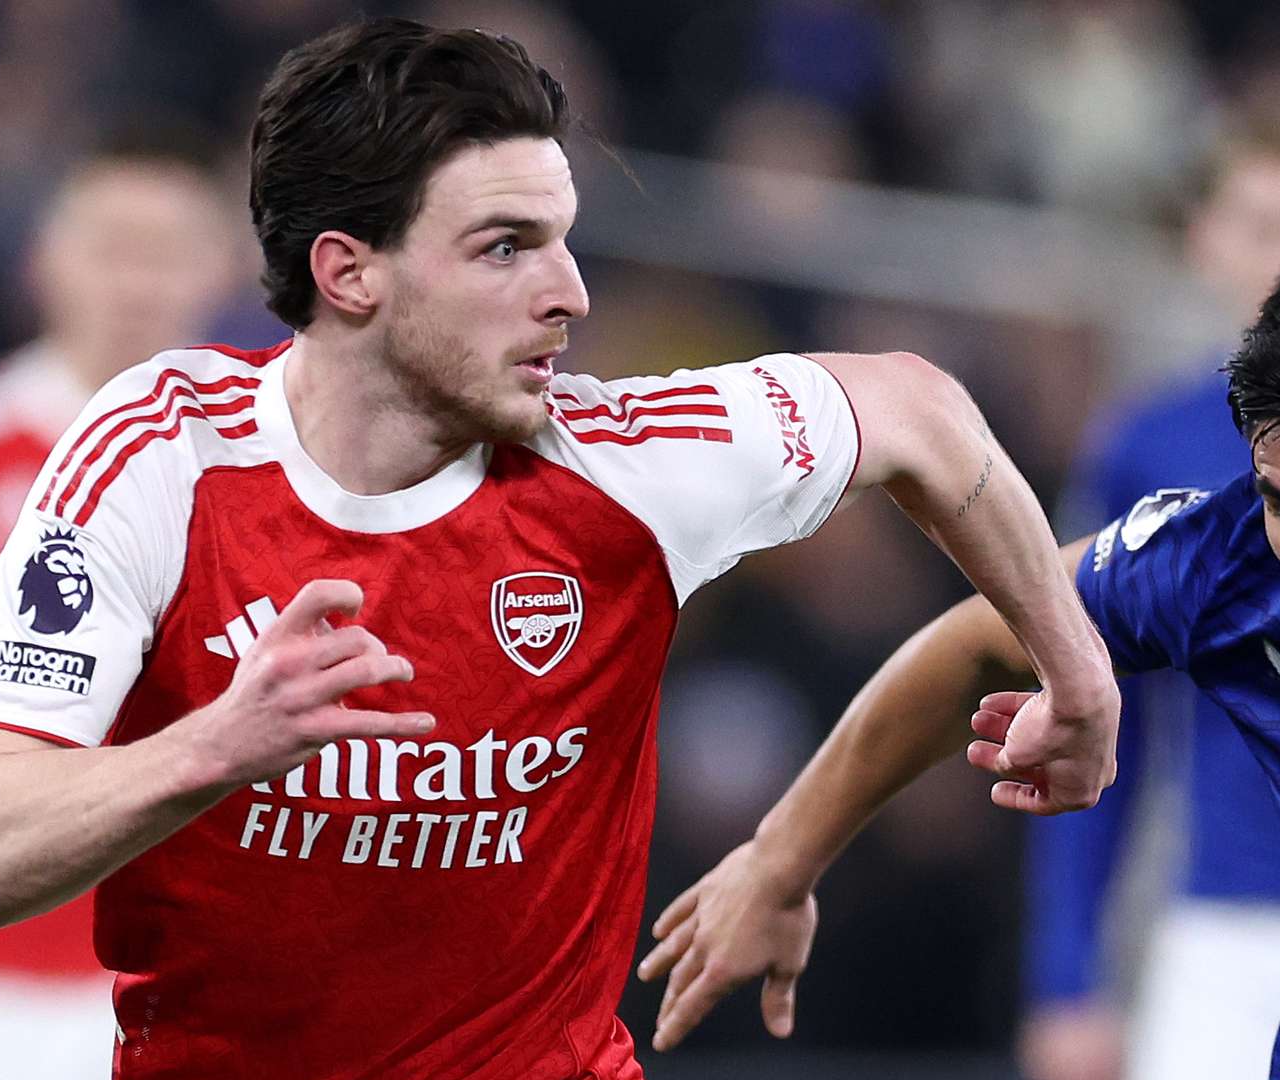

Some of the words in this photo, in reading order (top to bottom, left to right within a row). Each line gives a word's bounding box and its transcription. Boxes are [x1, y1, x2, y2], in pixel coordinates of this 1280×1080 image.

[504, 589, 569, 609] Arsenal
[22, 647, 85, 675] room
[17, 666, 90, 696] racism
[251, 727, 588, 801] mirates
[239, 803, 329, 860] FLY
[342, 806, 528, 869] BETTER
